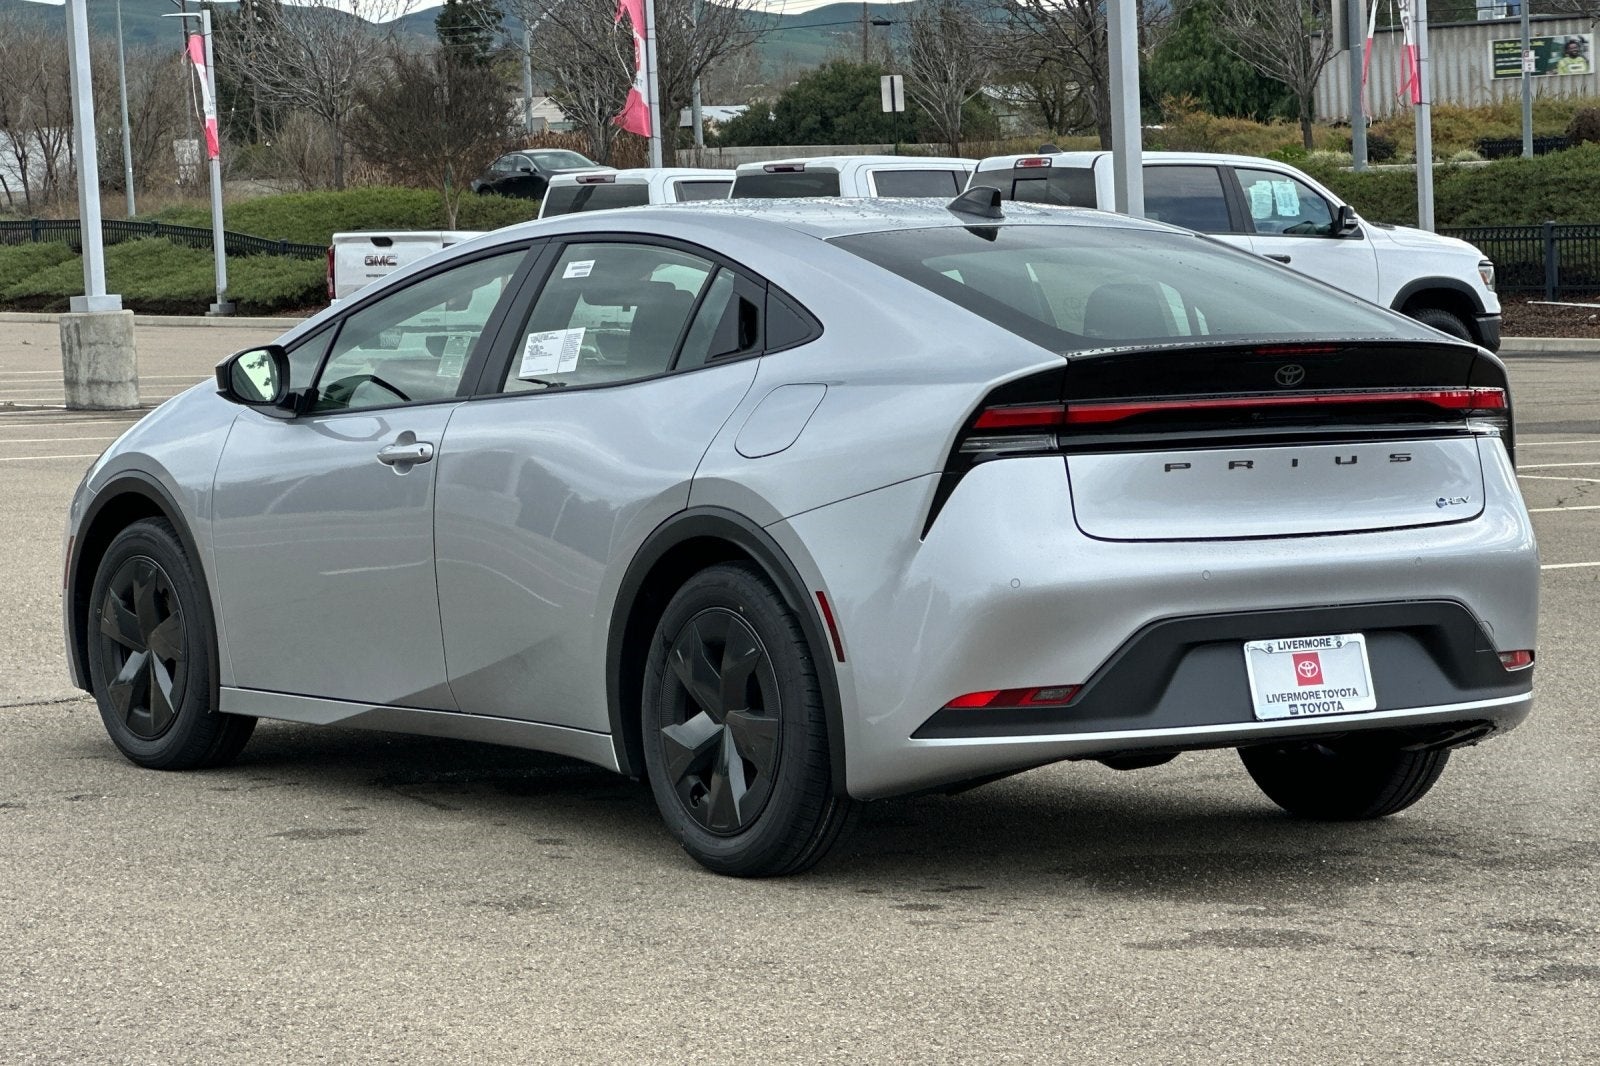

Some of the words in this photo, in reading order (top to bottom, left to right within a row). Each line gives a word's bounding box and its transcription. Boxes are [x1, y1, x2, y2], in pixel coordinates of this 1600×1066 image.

[365, 255, 398, 266] GMC
[1164, 453, 1413, 473] PRIUS
[1277, 637, 1333, 651] LIVERMORE
[1266, 690, 1321, 704] LIVERMORE
[1322, 687, 1359, 699] TOYOTA
[1299, 700, 1345, 714] TOYOTA
